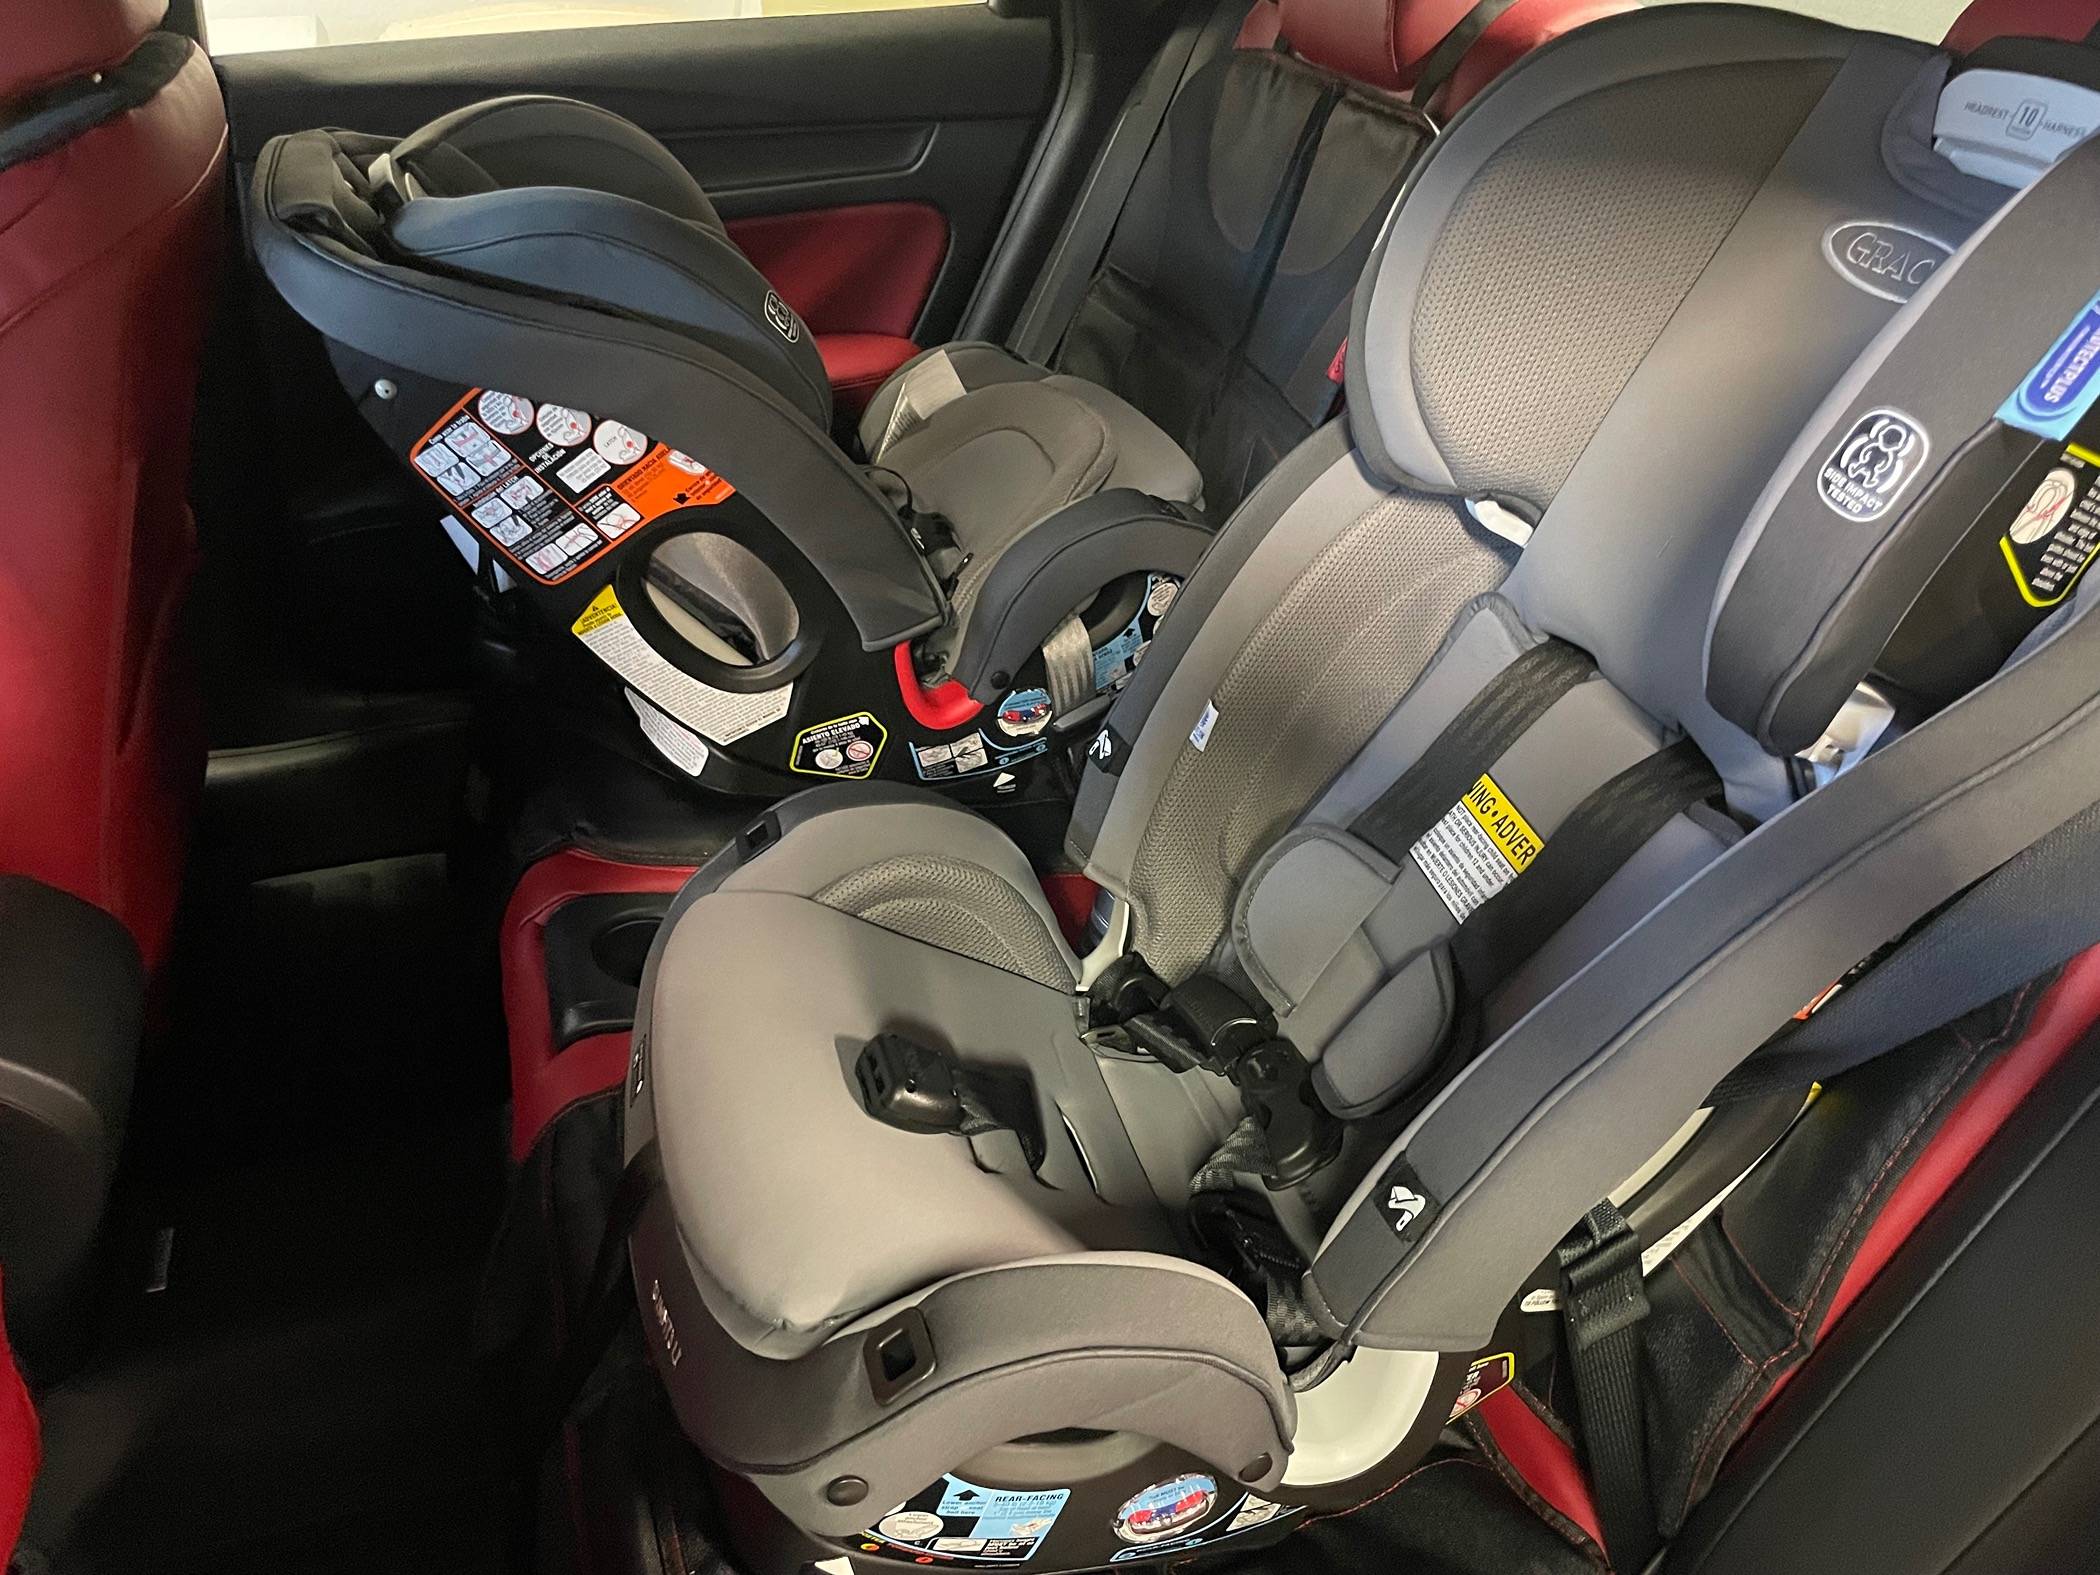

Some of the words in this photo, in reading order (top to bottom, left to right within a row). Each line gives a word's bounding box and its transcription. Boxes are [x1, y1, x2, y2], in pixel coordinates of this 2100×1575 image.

[2018, 106, 2039, 127] 10
[1846, 232, 1935, 284] GRAC
[1823, 466, 1847, 488] SIDE
[1843, 480, 1883, 511] IMPACT
[1826, 485, 1863, 514] TESTED
[801, 730, 830, 743] ASIENTO
[830, 722, 860, 735] ELEVADO
[1468, 780, 1496, 815] ING
[1491, 815, 1536, 866] ADVER
[995, 1493, 1063, 1501] REAR-FACING
